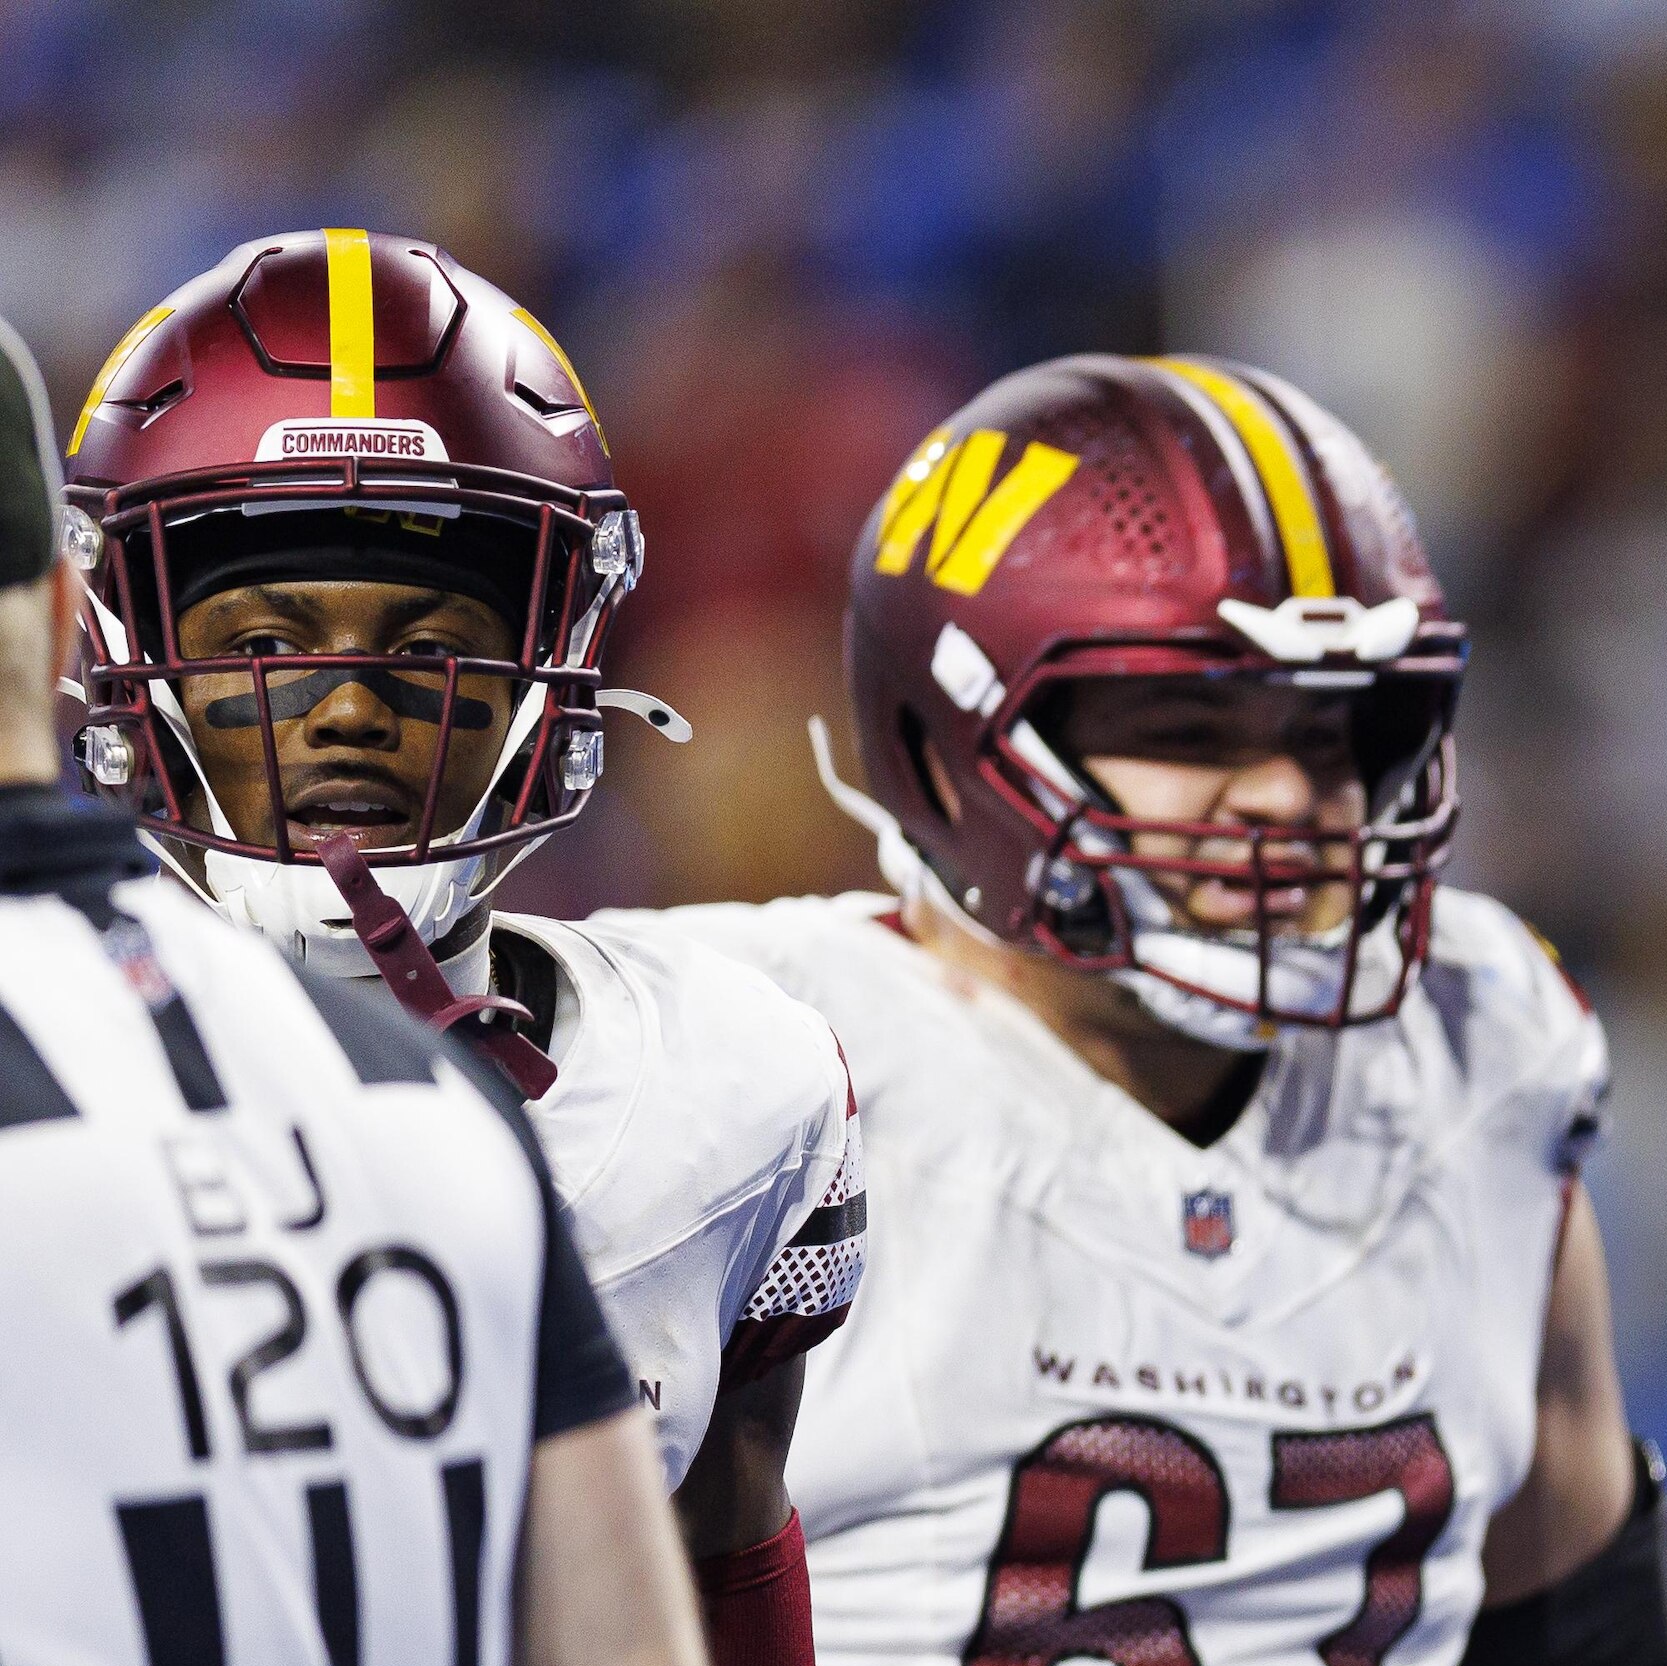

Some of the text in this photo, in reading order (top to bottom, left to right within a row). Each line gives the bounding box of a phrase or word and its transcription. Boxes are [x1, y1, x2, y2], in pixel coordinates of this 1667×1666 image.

[282, 433, 425, 457] COMMANDERS
[112, 1241, 462, 1463] 120
[1032, 1343, 1417, 1420] WASHINGTON
